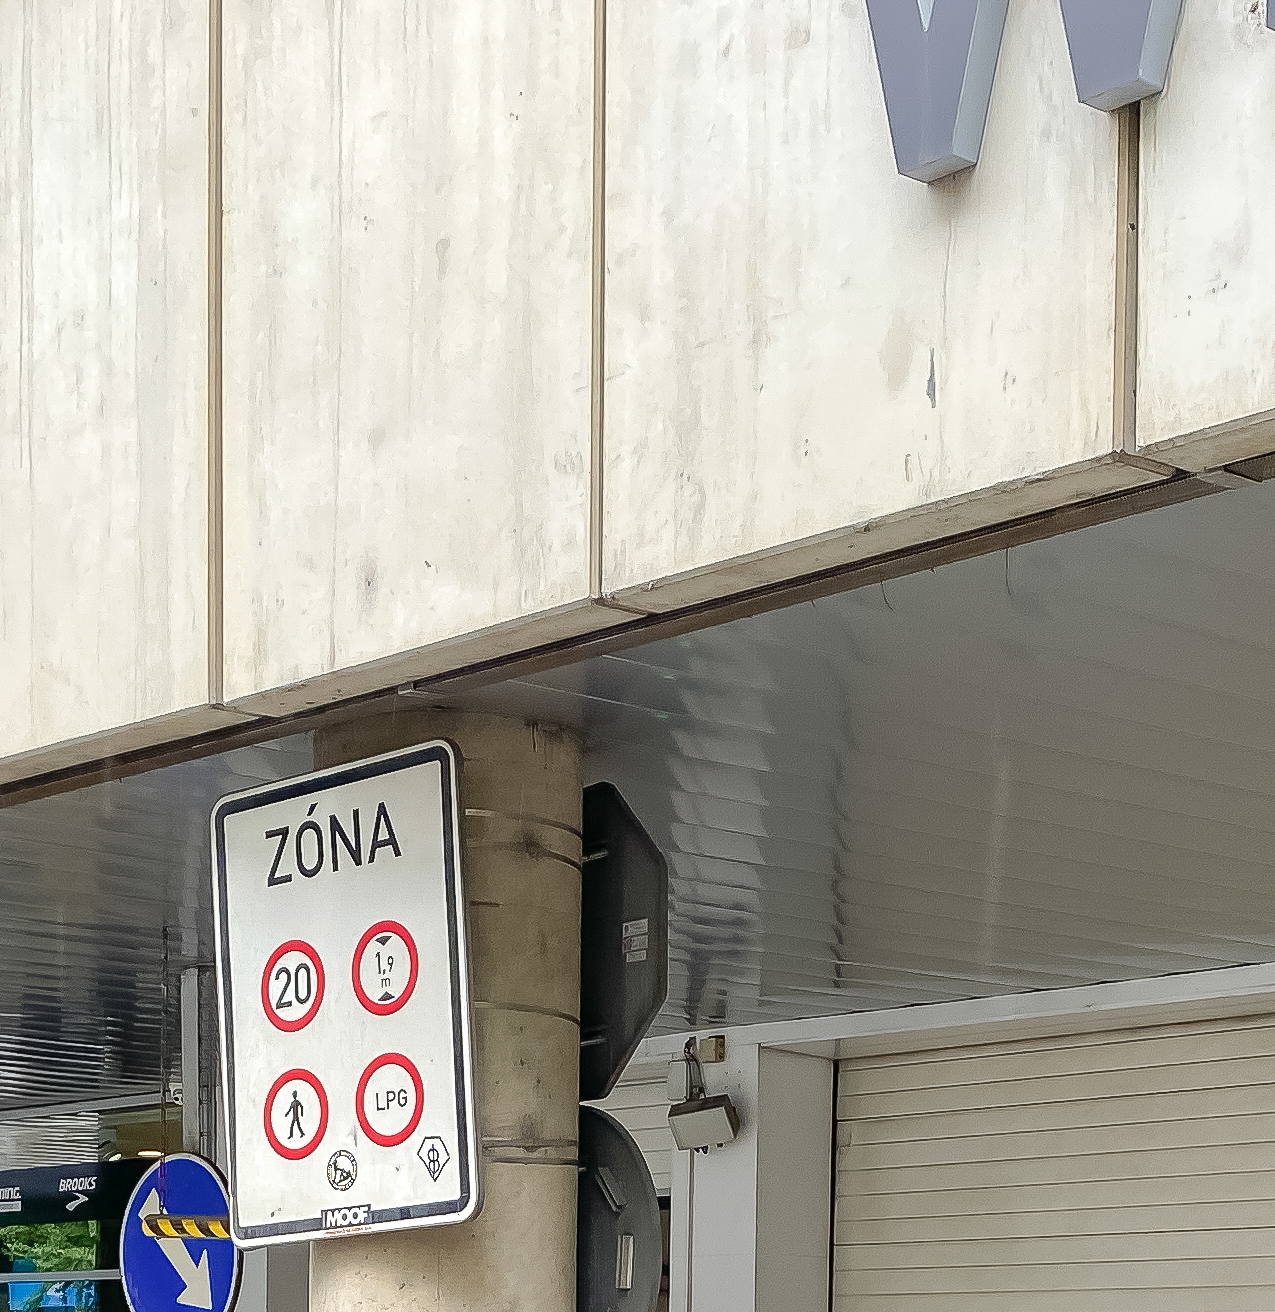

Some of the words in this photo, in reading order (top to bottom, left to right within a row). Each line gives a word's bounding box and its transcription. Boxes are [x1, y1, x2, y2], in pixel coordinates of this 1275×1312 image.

[264, 801, 402, 888] ZÓNA
[375, 951, 394, 977] 1,9
[274, 963, 312, 1010] 20
[375, 1088, 408, 1112] LPG
[58, 1176, 98, 1192] BROOKS
[324, 1206, 369, 1229] MOOF
